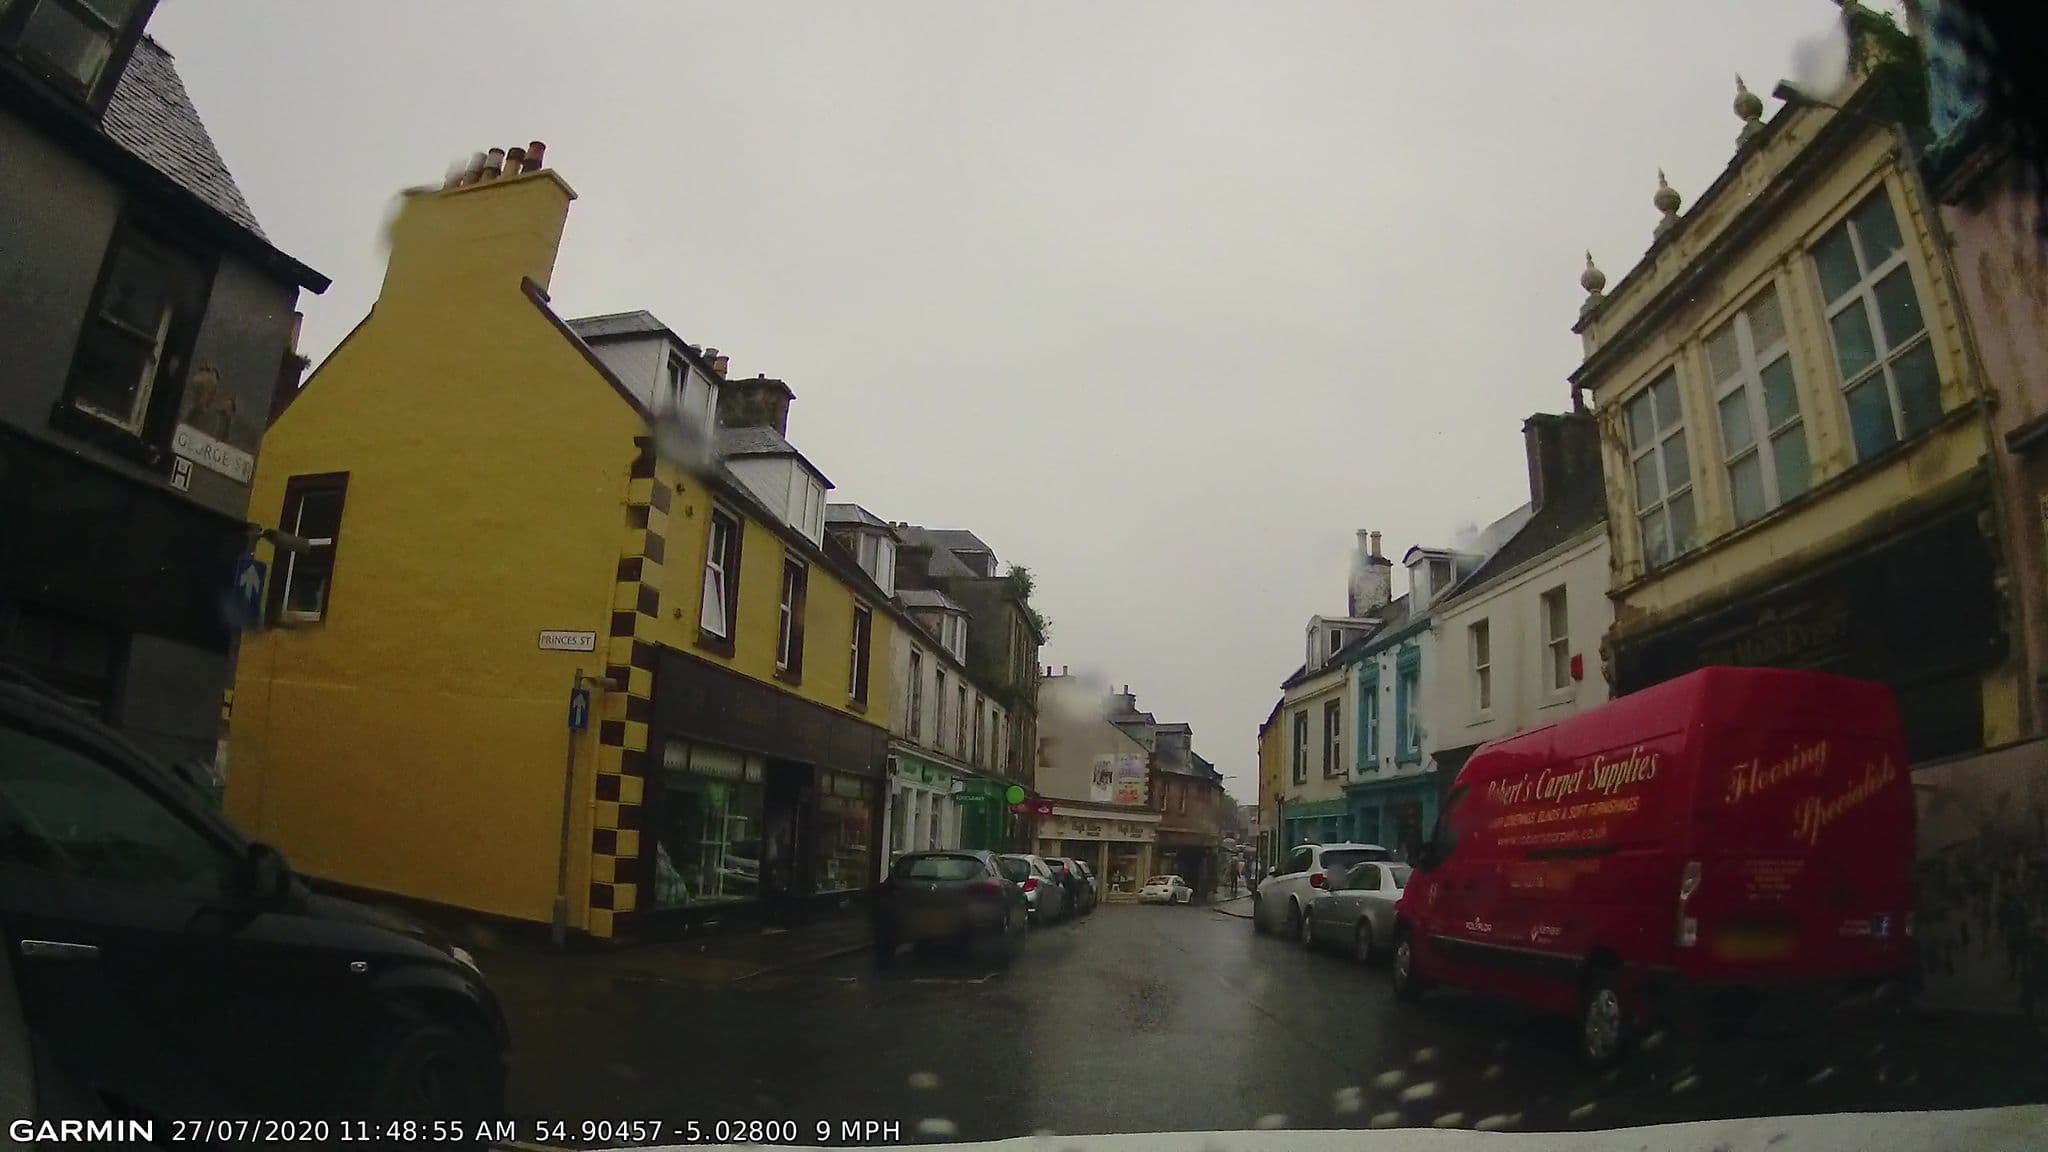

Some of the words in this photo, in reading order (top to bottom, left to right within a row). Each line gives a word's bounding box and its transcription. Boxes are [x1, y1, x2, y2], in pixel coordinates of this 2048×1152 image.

[172, 459, 190, 487] H
[540, 634, 577, 646] PRINCES
[580, 636, 592, 646] ST
[1536, 768, 1584, 803] Carpet
[1588, 745, 1660, 795] Supplies
[1725, 739, 1829, 806] Flooring
